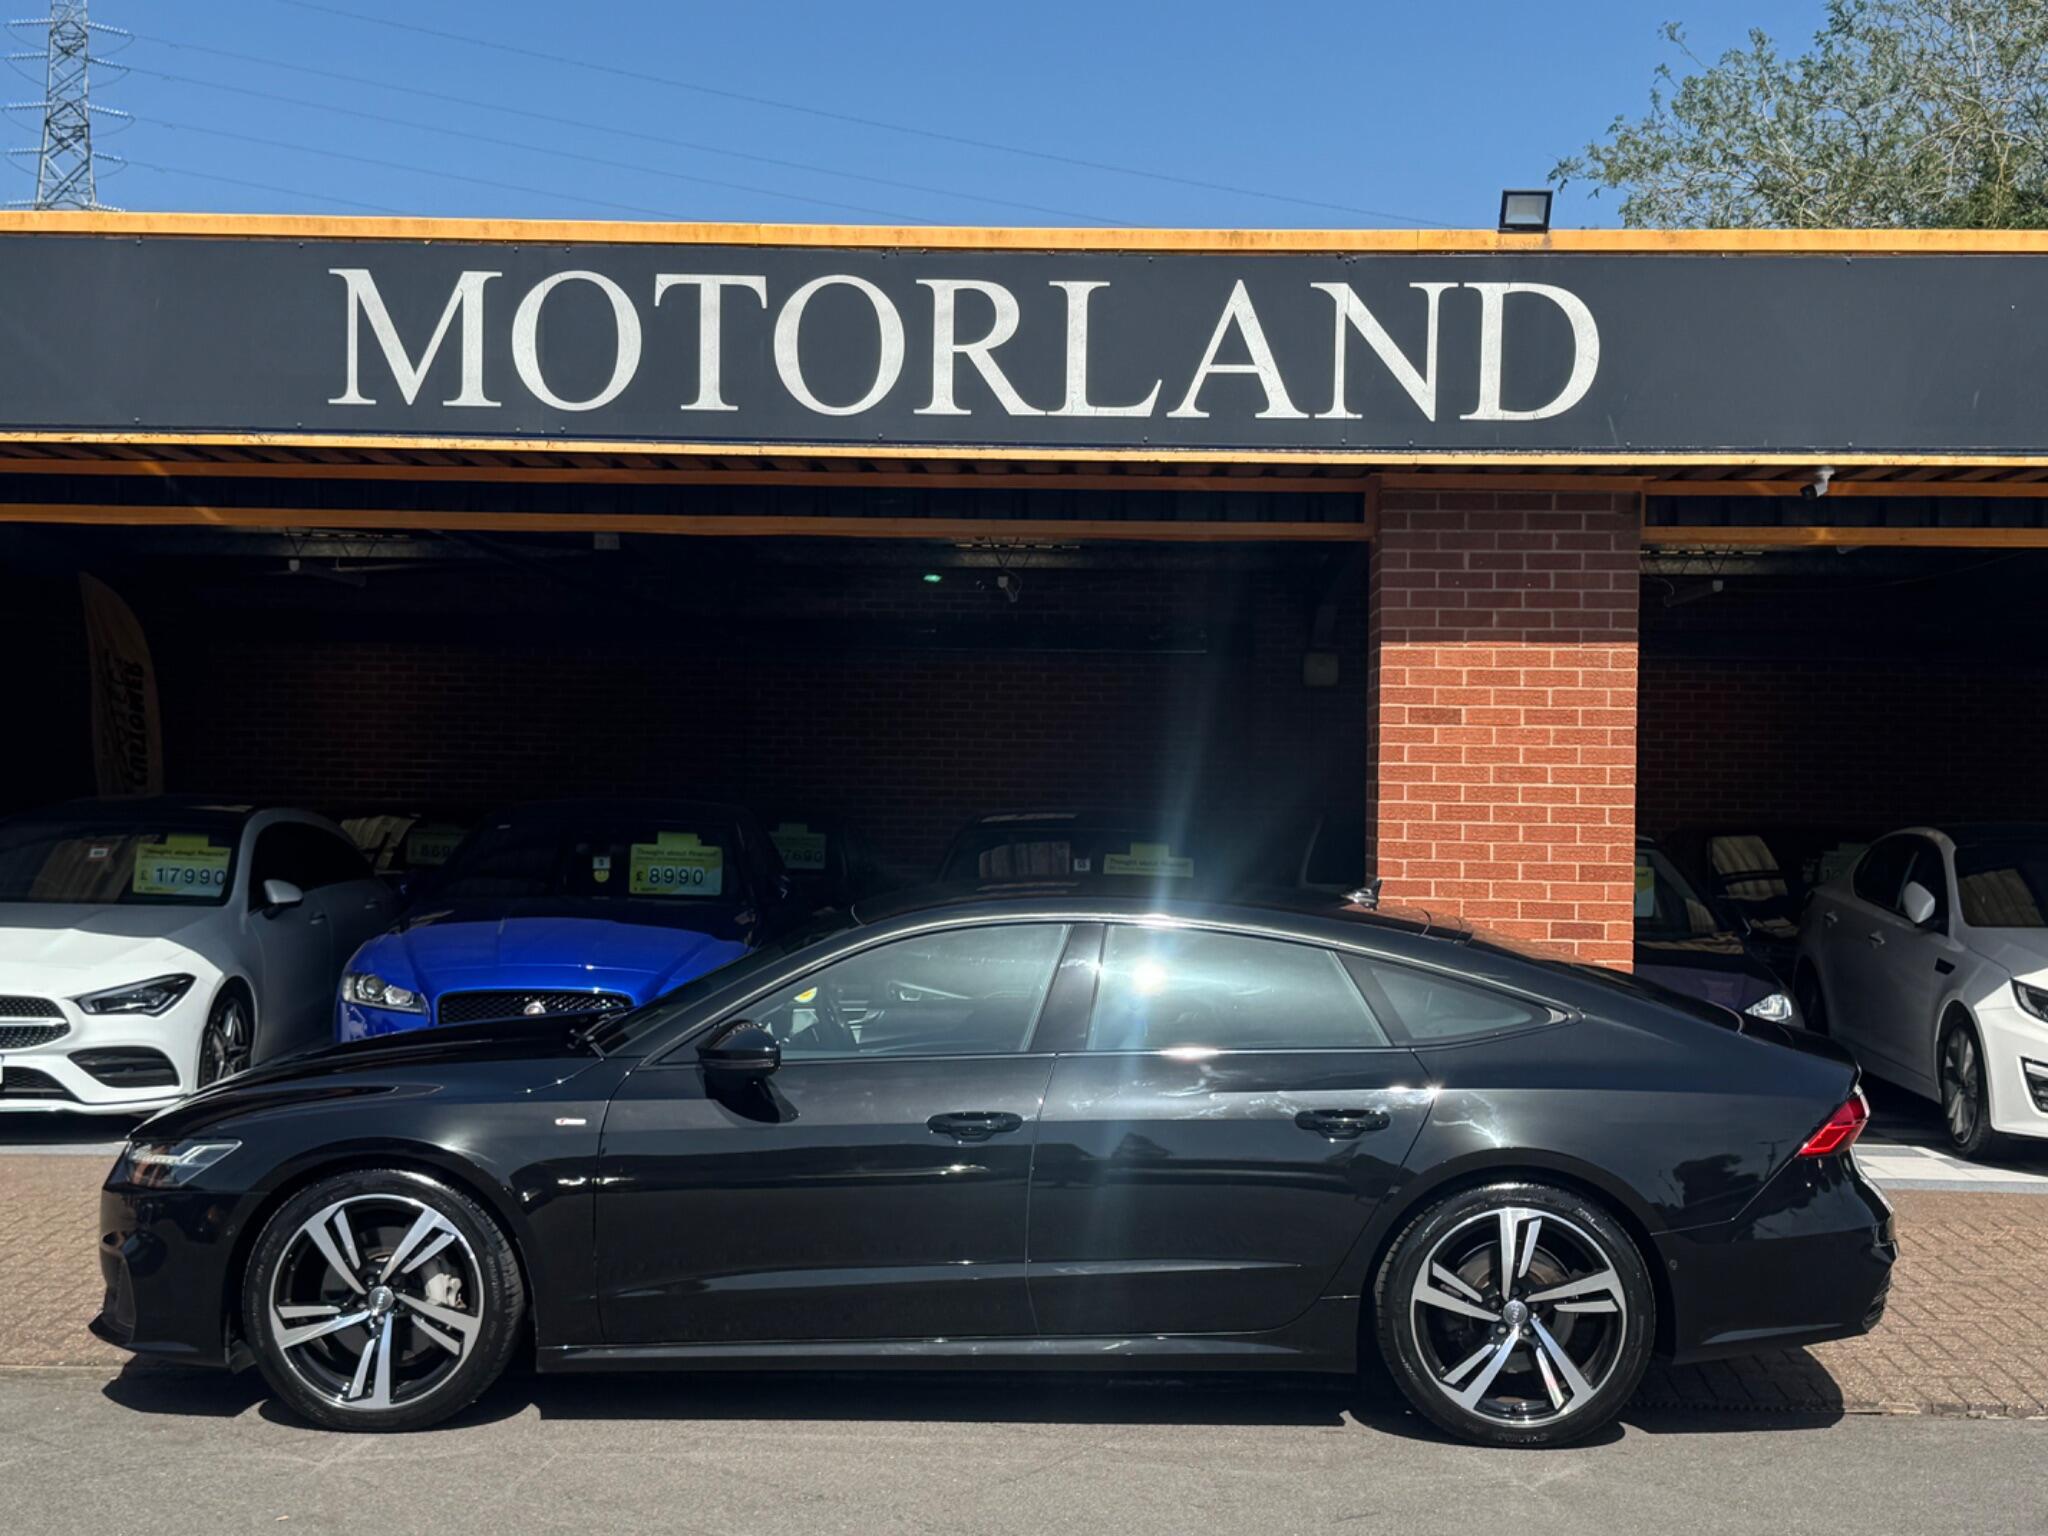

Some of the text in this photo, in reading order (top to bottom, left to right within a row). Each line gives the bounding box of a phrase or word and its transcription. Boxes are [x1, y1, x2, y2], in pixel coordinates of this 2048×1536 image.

[328, 268, 1600, 422] MOTORLAND
[156, 867, 226, 885] 17990
[649, 867, 704, 885] 8990
